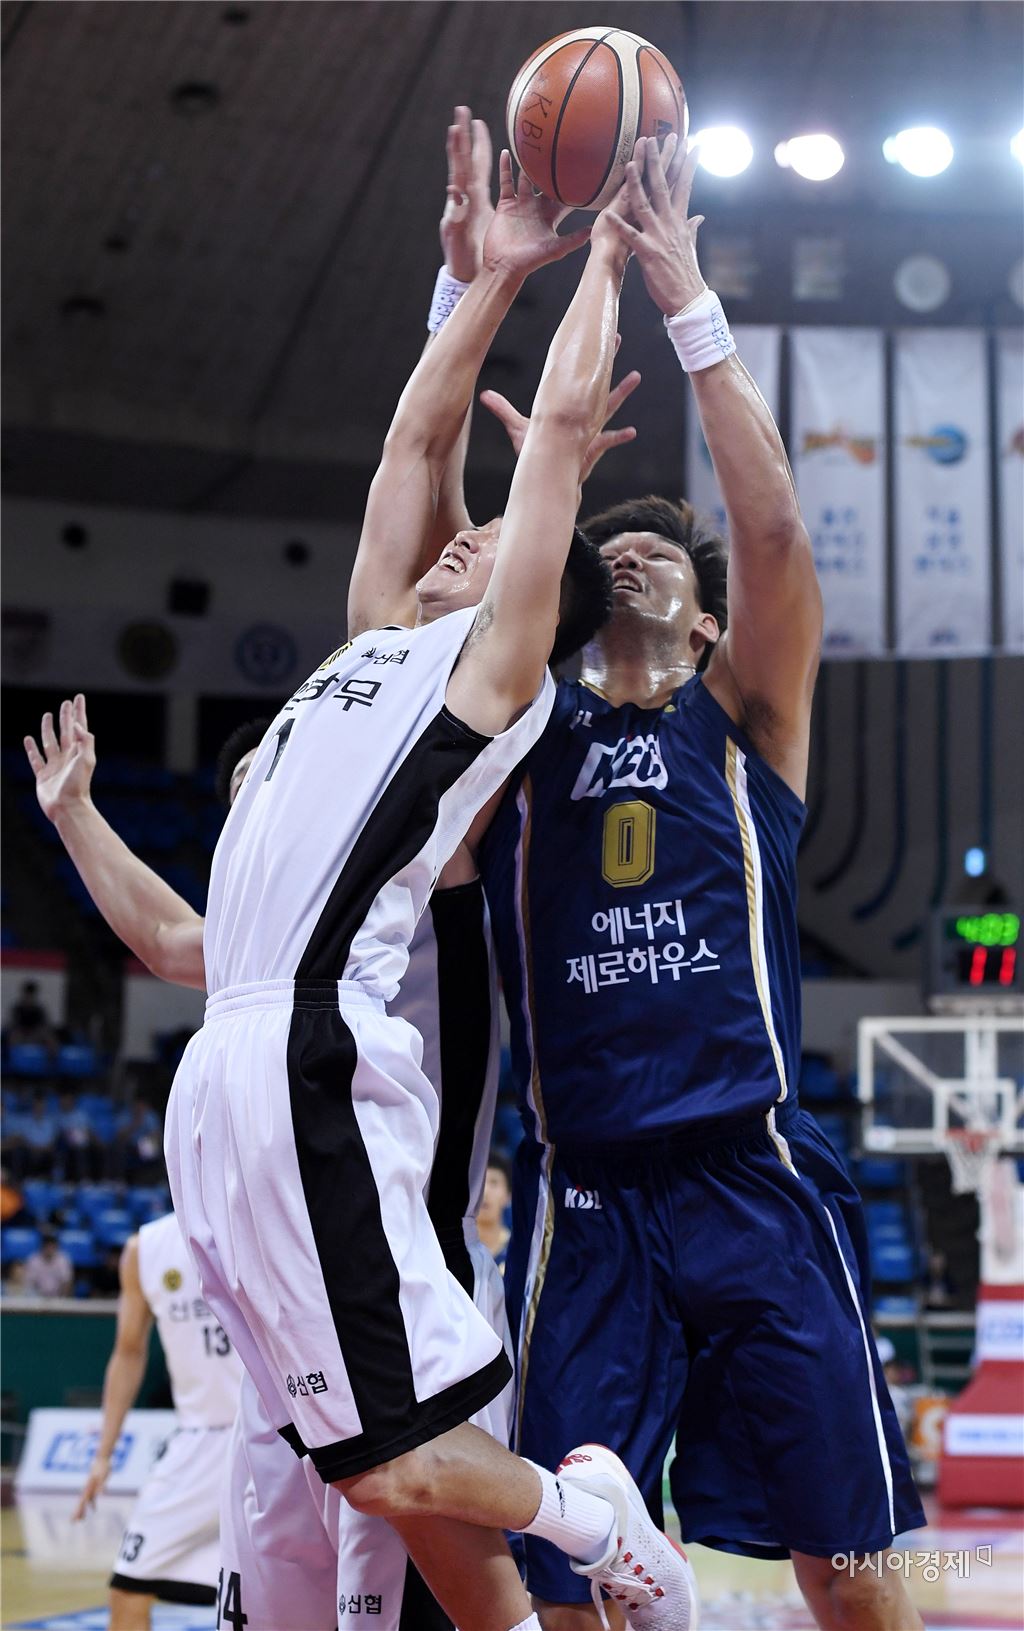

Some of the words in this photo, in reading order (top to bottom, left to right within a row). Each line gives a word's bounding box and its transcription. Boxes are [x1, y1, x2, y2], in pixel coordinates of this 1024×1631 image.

[602, 800, 657, 888] 0
[591, 899, 687, 946] 에너지
[566, 938, 721, 994] 제로하우스
[564, 1186, 603, 1210] KBL
[203, 1326, 231, 1357] 13
[297, 1370, 328, 1396] 신협
[348, 1594, 382, 1614] 신협
